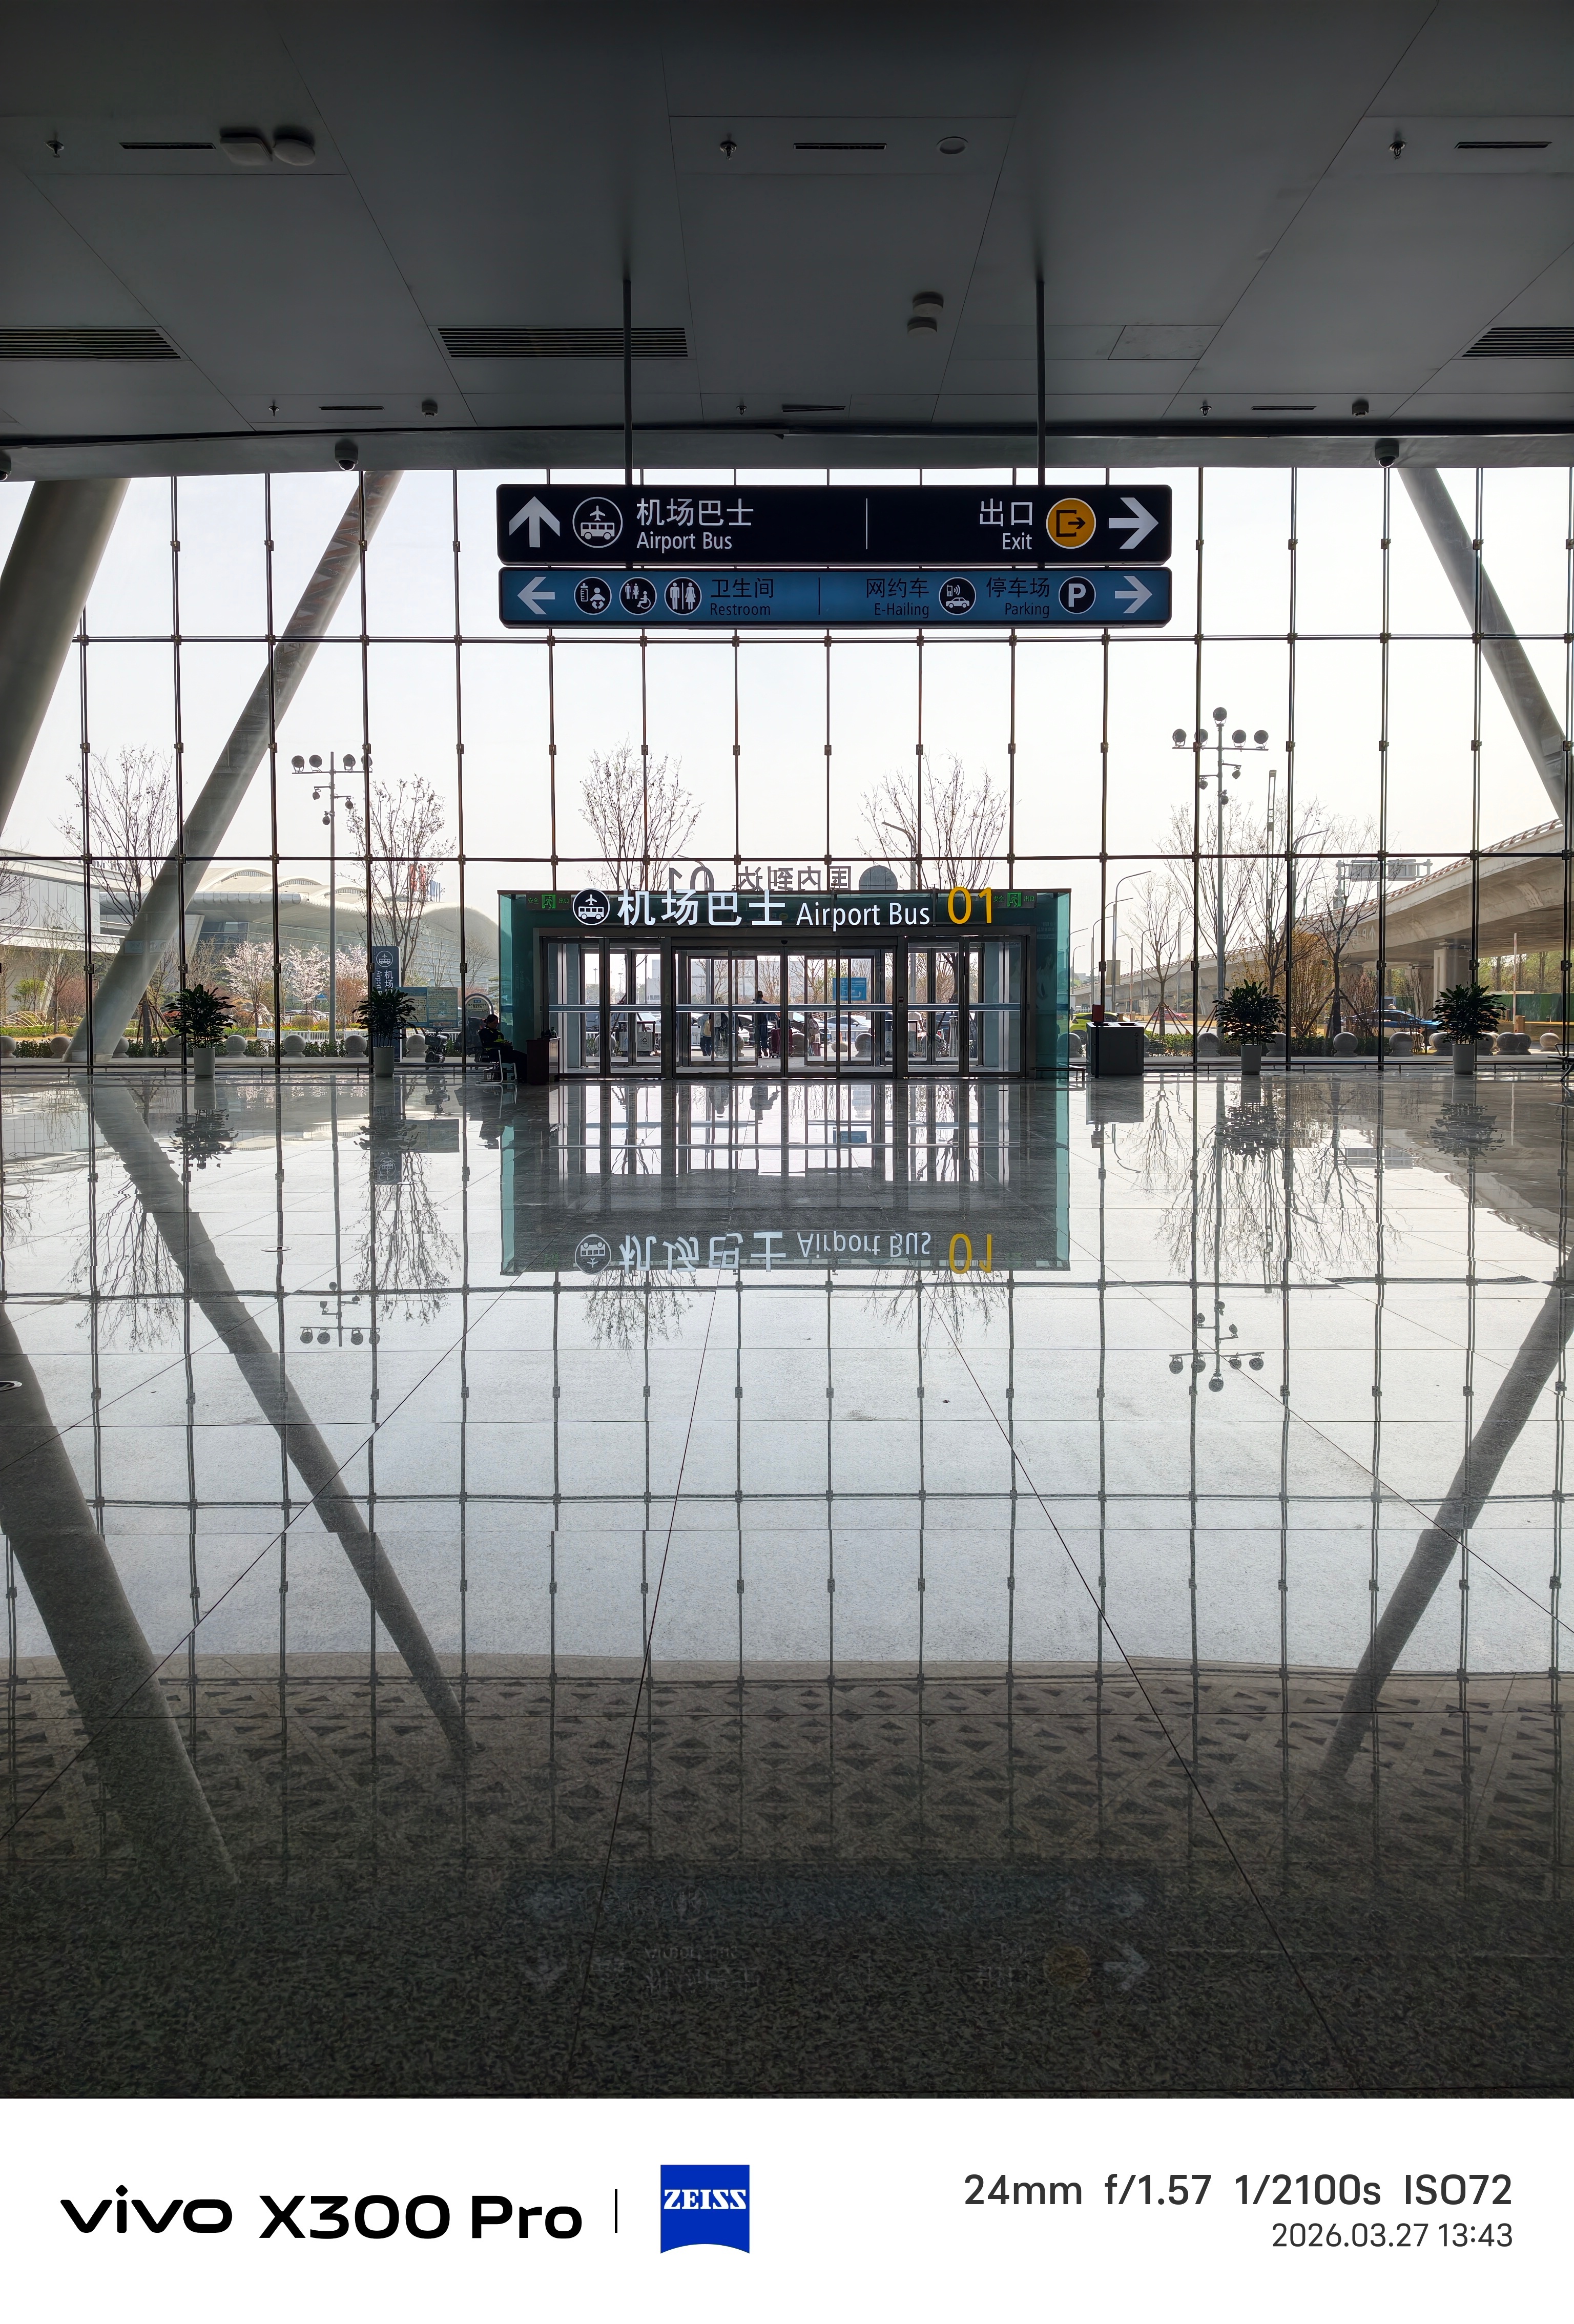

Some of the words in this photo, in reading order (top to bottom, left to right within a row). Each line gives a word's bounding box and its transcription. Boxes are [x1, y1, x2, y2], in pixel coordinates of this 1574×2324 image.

[637, 499, 754, 526] 机场巴士
[980, 499, 1033, 526] 出口
[637, 531, 696, 552] Airport
[703, 532, 732, 549] Bus
[1003, 532, 1032, 549] Exit
[711, 578, 774, 598] 卫生间
[867, 578, 929, 598] 网约车
[986, 577, 1049, 597] 停车场
[1069, 584, 1086, 607] P
[711, 603, 771, 615] Restroom
[875, 602, 929, 618] E-Hailing
[1005, 602, 1049, 618] Parking
[617, 889, 785, 925] 机场巴士
[796, 902, 880, 931] Airport
[890, 903, 930, 925] Bus
[948, 887, 992, 924] 01
[384, 970, 394, 995] 机场
